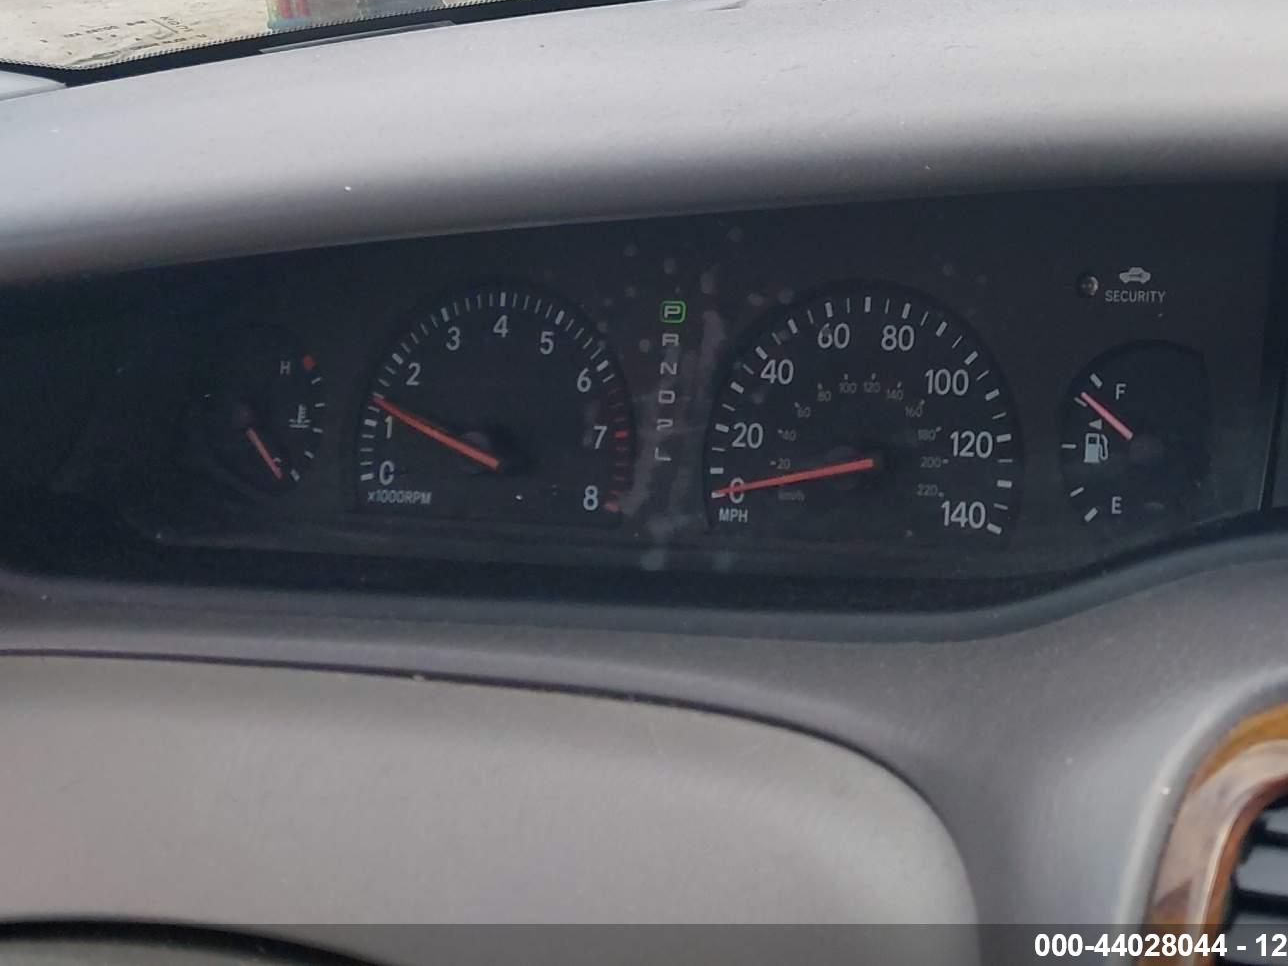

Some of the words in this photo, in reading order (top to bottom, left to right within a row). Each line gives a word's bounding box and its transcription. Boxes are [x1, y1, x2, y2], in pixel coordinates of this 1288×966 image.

[1105, 290, 1166, 303] SECURITY
[664, 305, 681, 318] P
[493, 315, 508, 337] 4
[818, 323, 850, 349] 60
[881, 324, 915, 351] 80
[446, 327, 460, 351] 3
[540, 331, 554, 354] 5
[662, 333, 679, 347] R
[280, 361, 291, 375] H
[406, 362, 421, 386] 2
[577, 368, 591, 392] 6
[660, 362, 677, 375] N
[760, 359, 794, 385] 40
[863, 381, 881, 394] 120
[925, 369, 969, 396] 100
[1115, 383, 1126, 400] F
[384, 415, 394, 439] 1
[594, 426, 607, 450] 7
[731, 422, 764, 449] 20
[654, 447, 672, 461] L
[950, 431, 993, 459] 120
[583, 486, 598, 511] 8
[1111, 497, 1122, 514] E
[719, 508, 749, 523] MPH
[941, 501, 986, 529] 140
